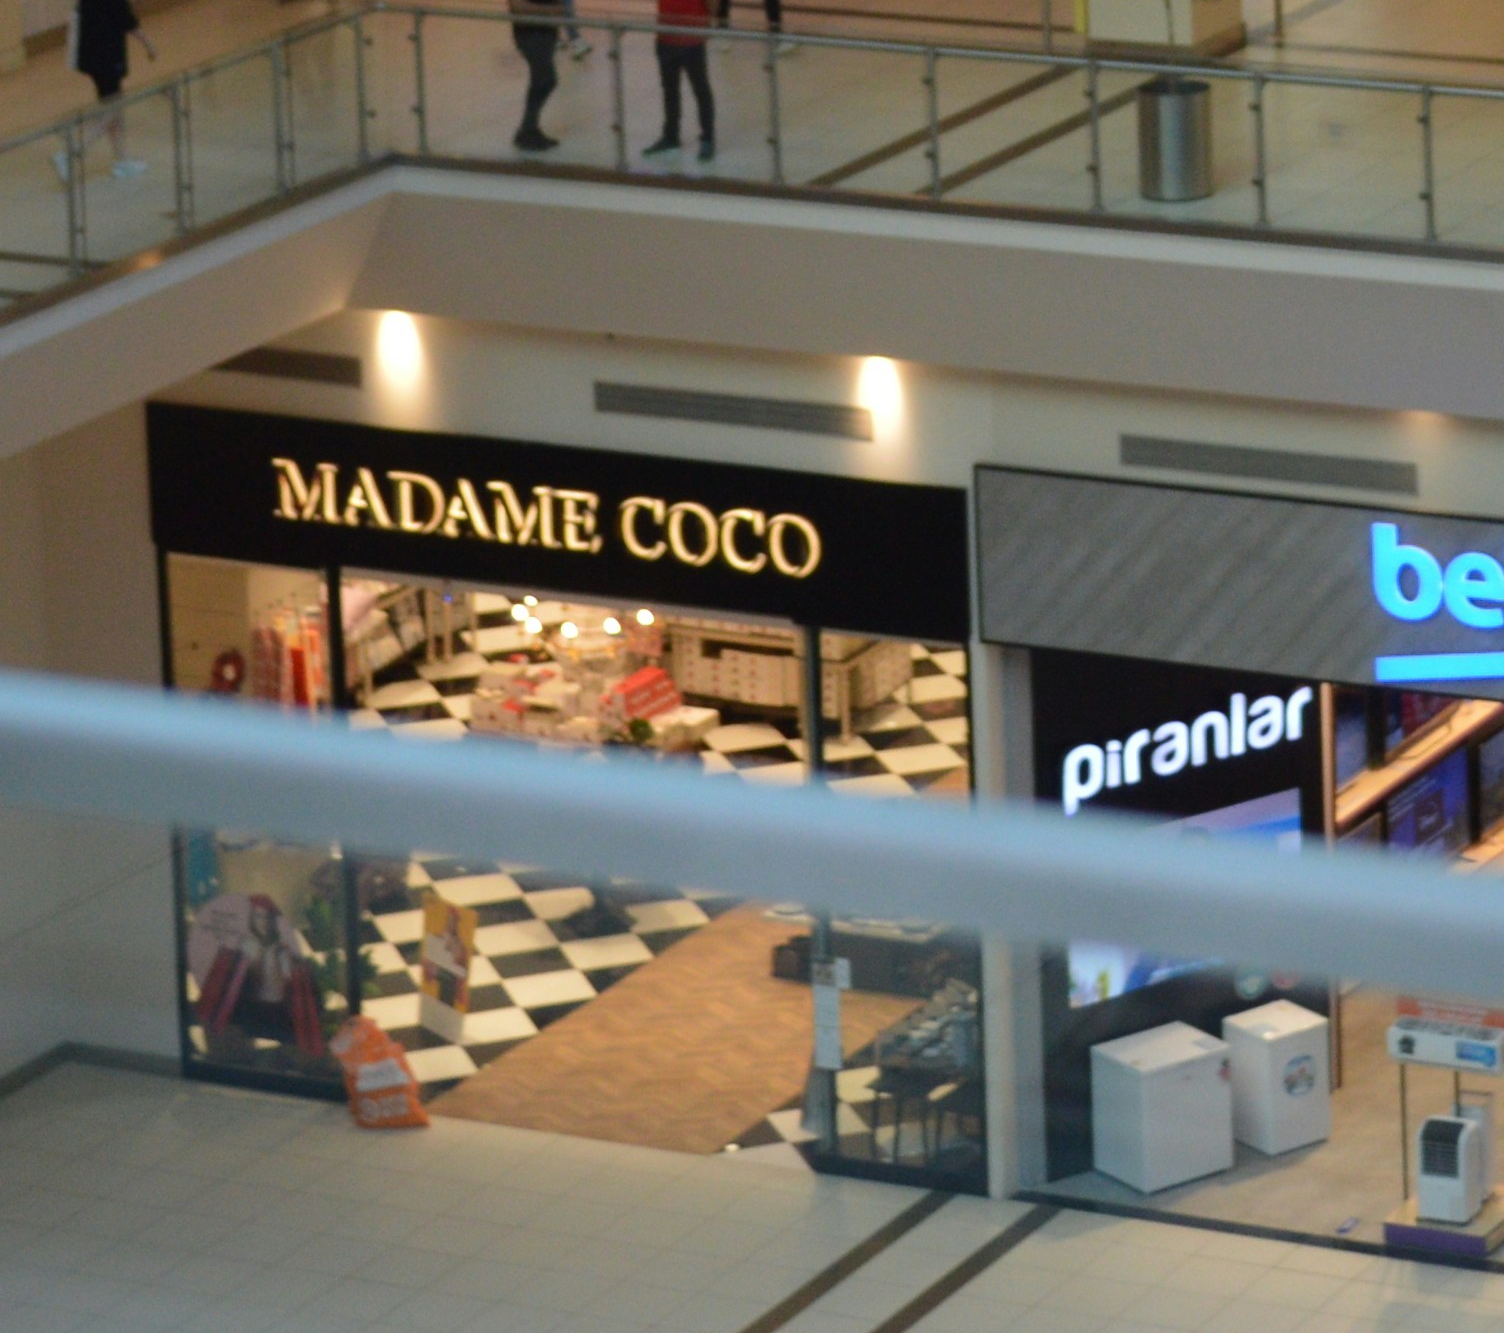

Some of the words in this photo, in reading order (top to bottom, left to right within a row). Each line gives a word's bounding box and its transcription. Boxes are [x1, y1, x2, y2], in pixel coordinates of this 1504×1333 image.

[272, 456, 602, 553] MADAME
[619, 495, 823, 579] COCO
[1062, 685, 1314, 819] piranlar
